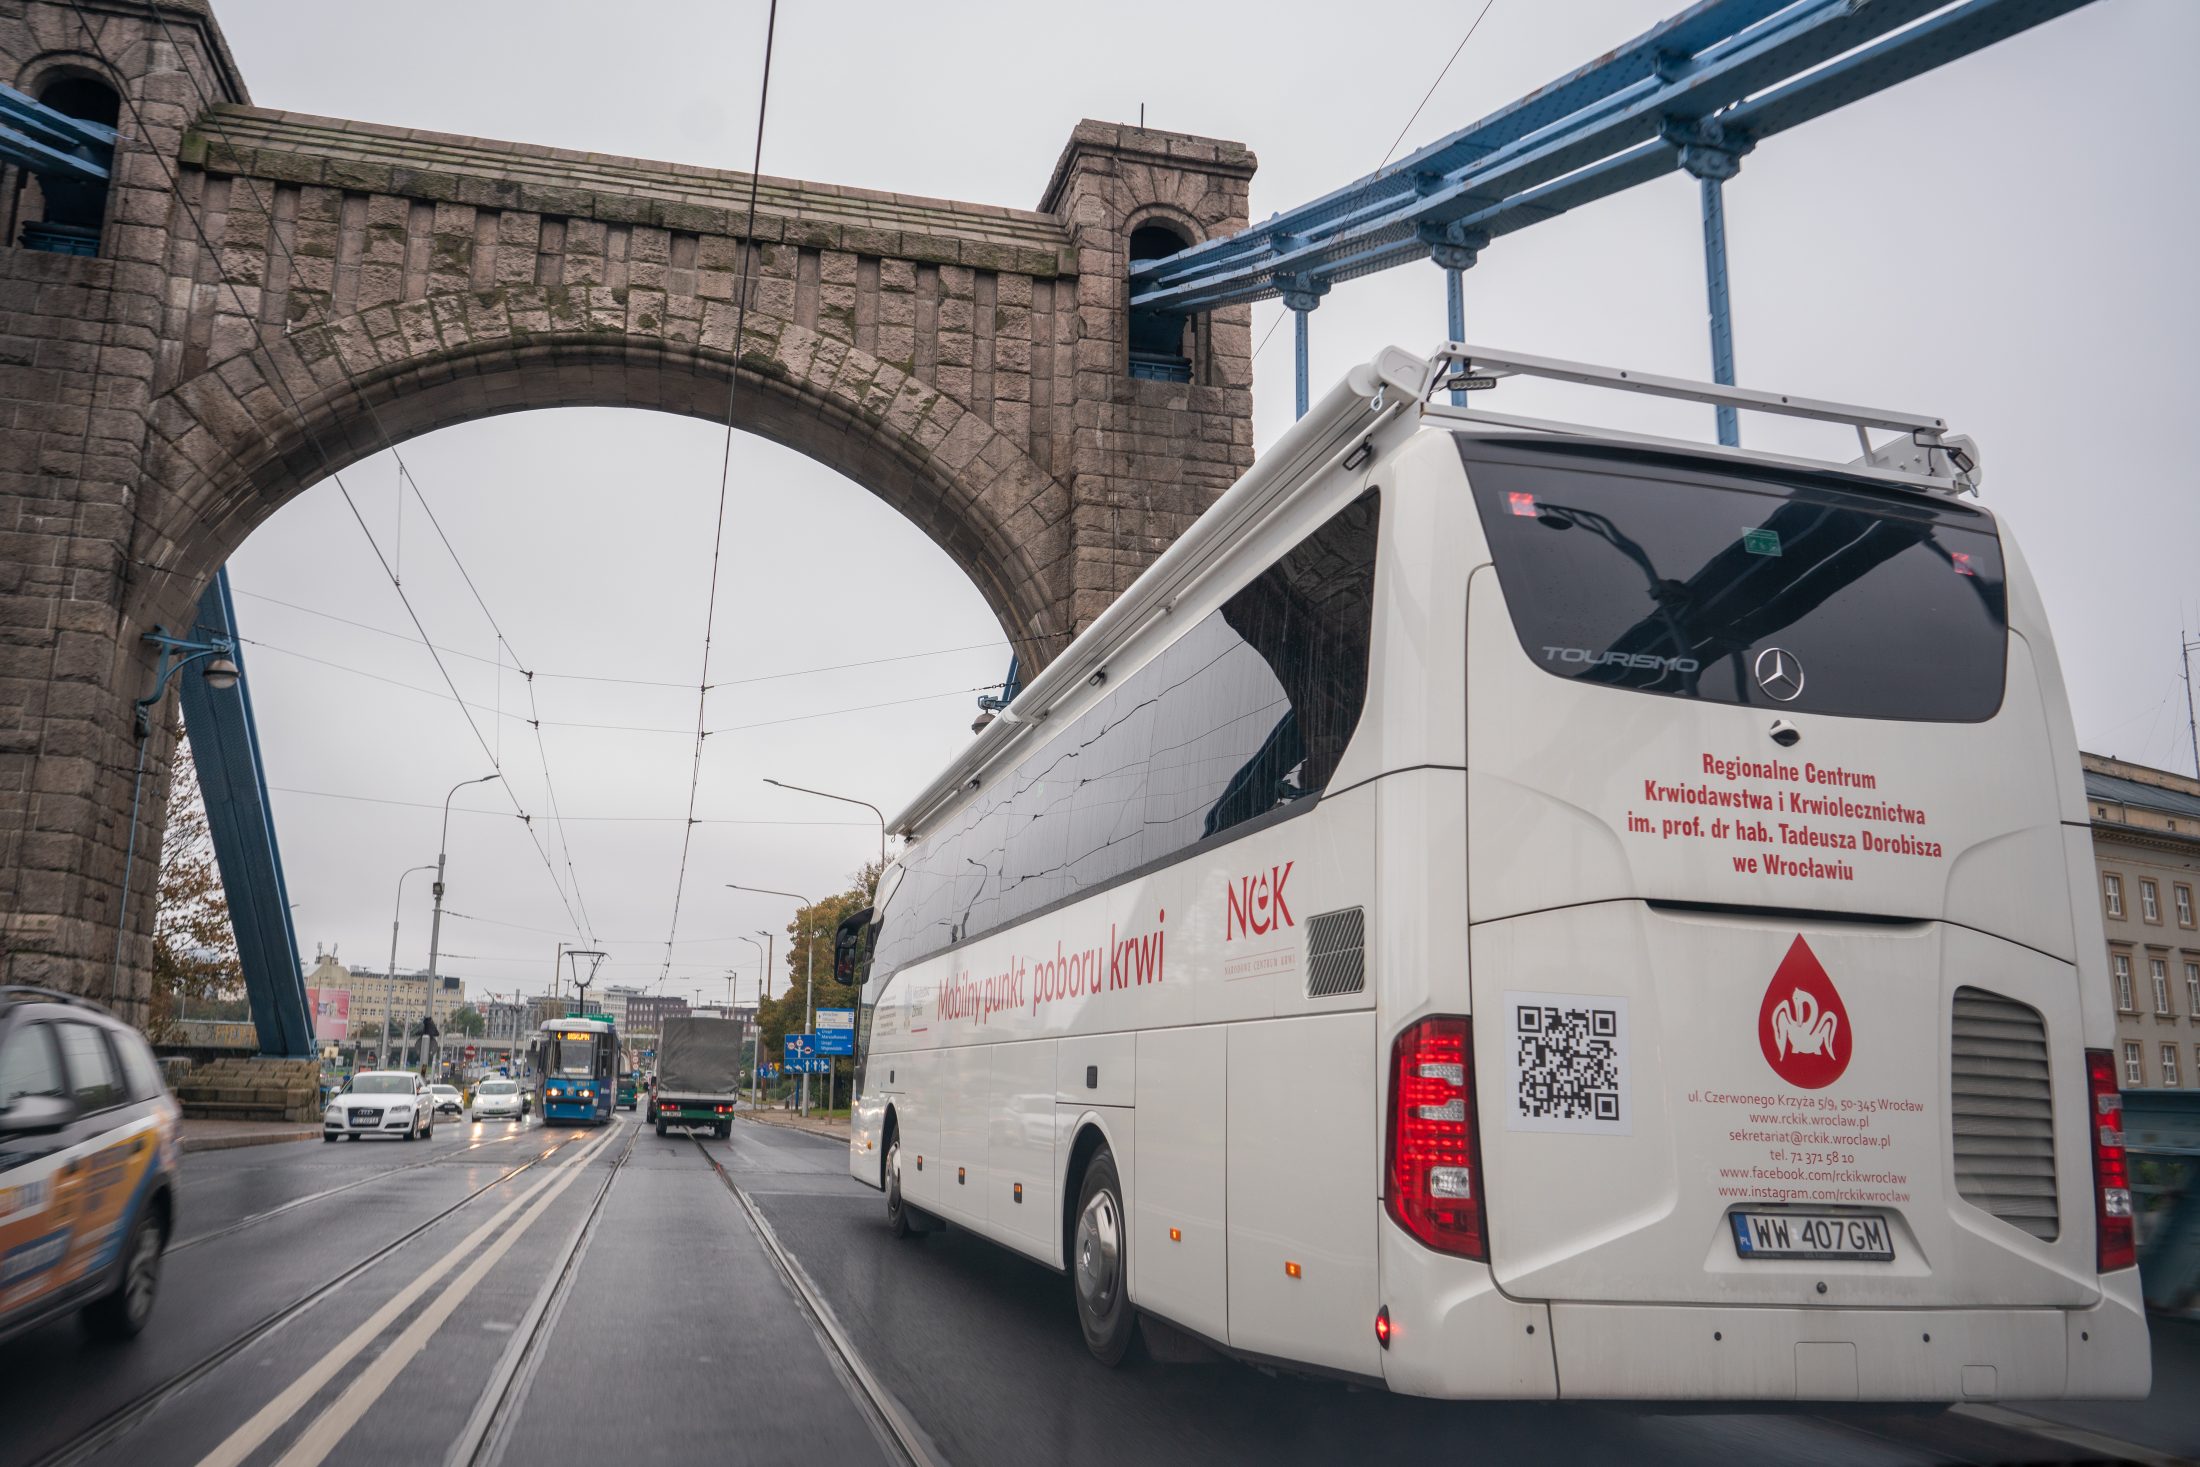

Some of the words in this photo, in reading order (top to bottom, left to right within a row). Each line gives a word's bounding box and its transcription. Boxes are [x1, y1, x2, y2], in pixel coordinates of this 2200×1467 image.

[1542, 646, 1699, 673] TOURISMO
[1702, 753, 1799, 782] Regionalne
[1805, 762, 1876, 790] Centrum
[1644, 780, 1773, 811] Krwiodawstwa
[1778, 791, 1785, 812] i
[1790, 792, 1926, 825] Krwiolecznictwa
[1627, 811, 1656, 833] im.
[1662, 816, 1705, 839] prof.
[1711, 818, 1730, 839] dr
[1736, 820, 1774, 843] hab.
[1778, 823, 1857, 850] Tadeusza
[1862, 830, 1942, 858] Dorobisza
[1733, 856, 1758, 873] we
[1762, 853, 1854, 881] Wrocławiu
[1226, 860, 1295, 941] NCK
[937, 965, 983, 1026] Mobilny
[984, 954, 1025, 1026] punkt
[1033, 940, 1103, 1017] poboru
[1110, 908, 1165, 991] krwi
[1688, 1090, 1702, 1103] ul.
[1704, 1091, 1775, 1108] Czerwonego
[1777, 1094, 1815, 1109] Krzyża
[1818, 1097, 1838, 1111] 5/9,
[1840, 1099, 1877, 1112] 50-345
[1877, 1098, 1924, 1112] Wrocław
[1749, 1113, 1870, 1128] www.rckik.wroclaw.pl
[1729, 1129, 1891, 1147] sekretariat@rckik.wroclaw.pl
[1770, 1149, 1788, 1161] tel.
[1790, 1152, 1802, 1164] 71
[1805, 1153, 1823, 1165] 371
[1826, 1151, 1839, 1165] 58
[1842, 1154, 1854, 1164] 10
[1720, 1166, 1907, 1184] www.facebook.com/rckikwroclaw
[1718, 1185, 1911, 1203] www.instagram.com/rckikwroclaw
[1739, 1236, 1751, 1246] PL
[1753, 1218, 1791, 1249] WW
[1801, 1220, 1885, 1251] 407GM
